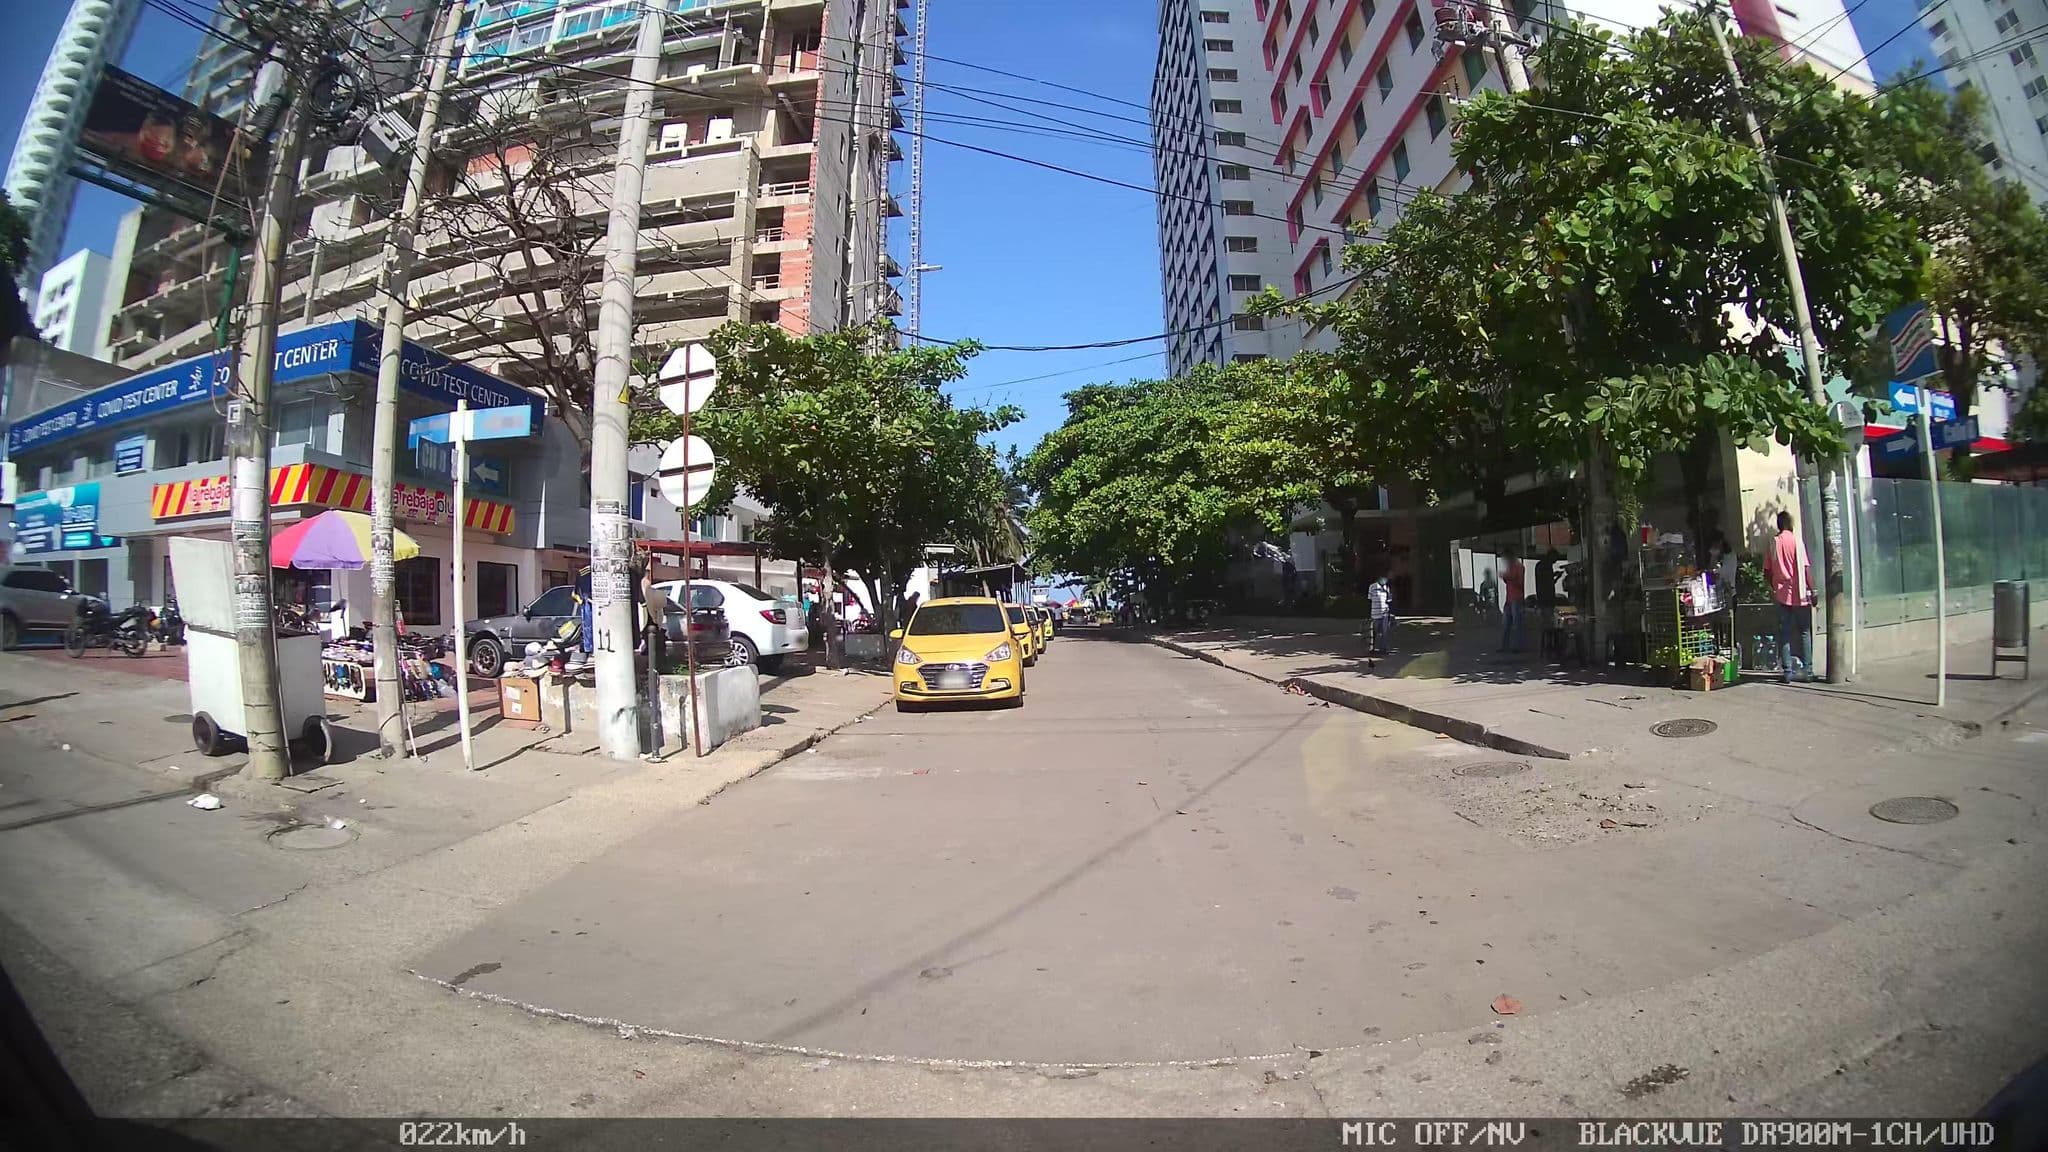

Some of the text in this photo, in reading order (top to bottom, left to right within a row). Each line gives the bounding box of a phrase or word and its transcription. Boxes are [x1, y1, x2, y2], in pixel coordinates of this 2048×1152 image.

[284, 339, 338, 369] CENTER
[98, 380, 178, 418] COVID TEST CENTER
[443, 373, 470, 398] TEST
[471, 384, 510, 407] CENTER
